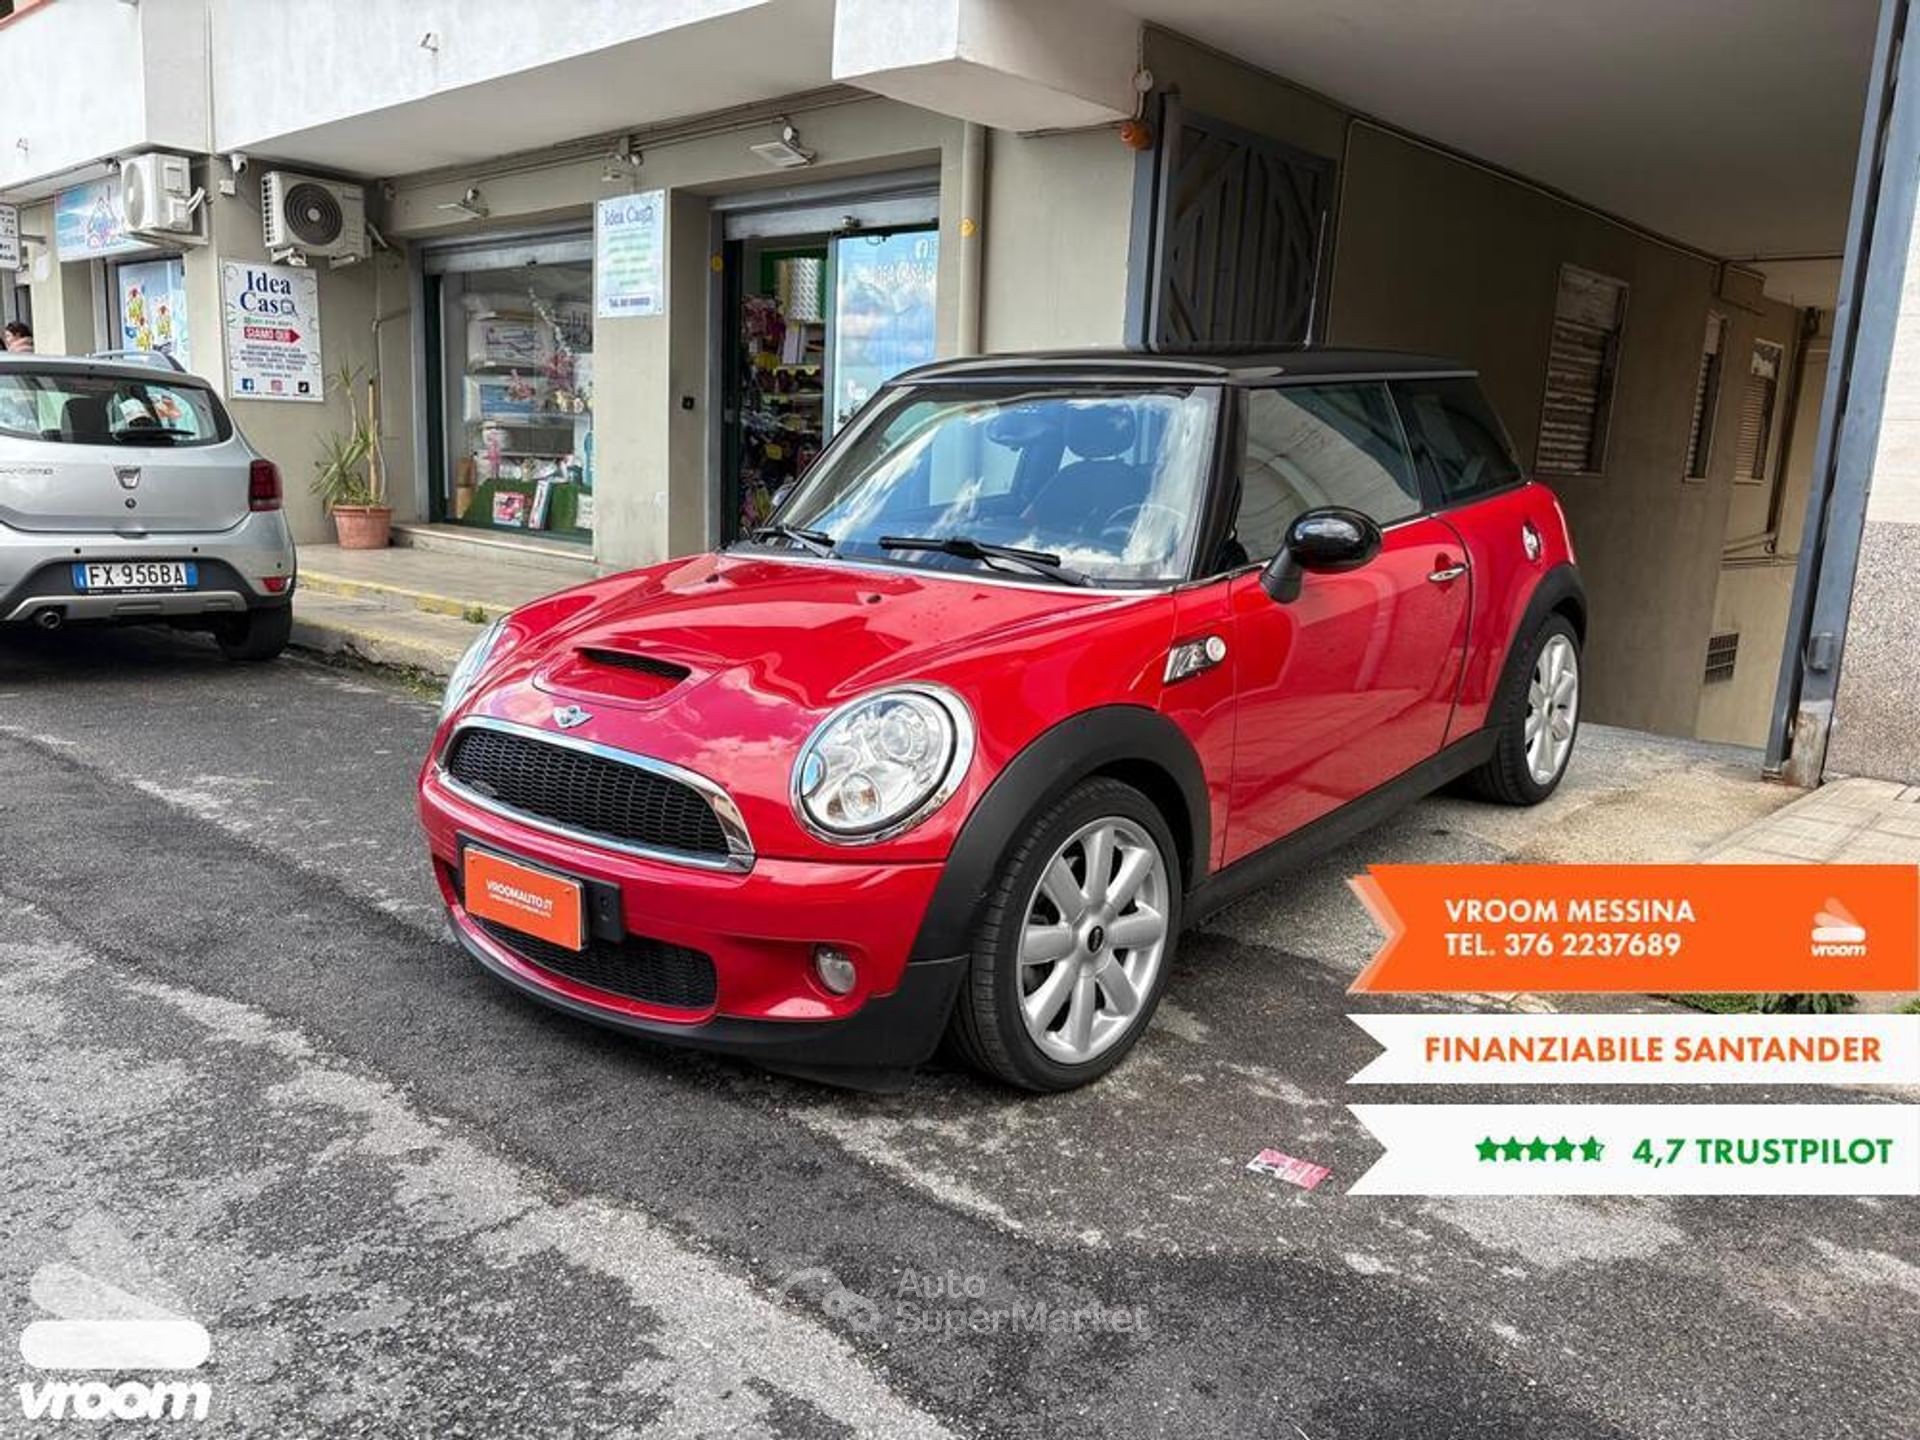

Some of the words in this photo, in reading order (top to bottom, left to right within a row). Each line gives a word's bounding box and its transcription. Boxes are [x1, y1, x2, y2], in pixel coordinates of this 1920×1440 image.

[246, 270, 292, 296] Idea
[88, 565, 115, 586] FX
[121, 564, 185, 585] 956BA
